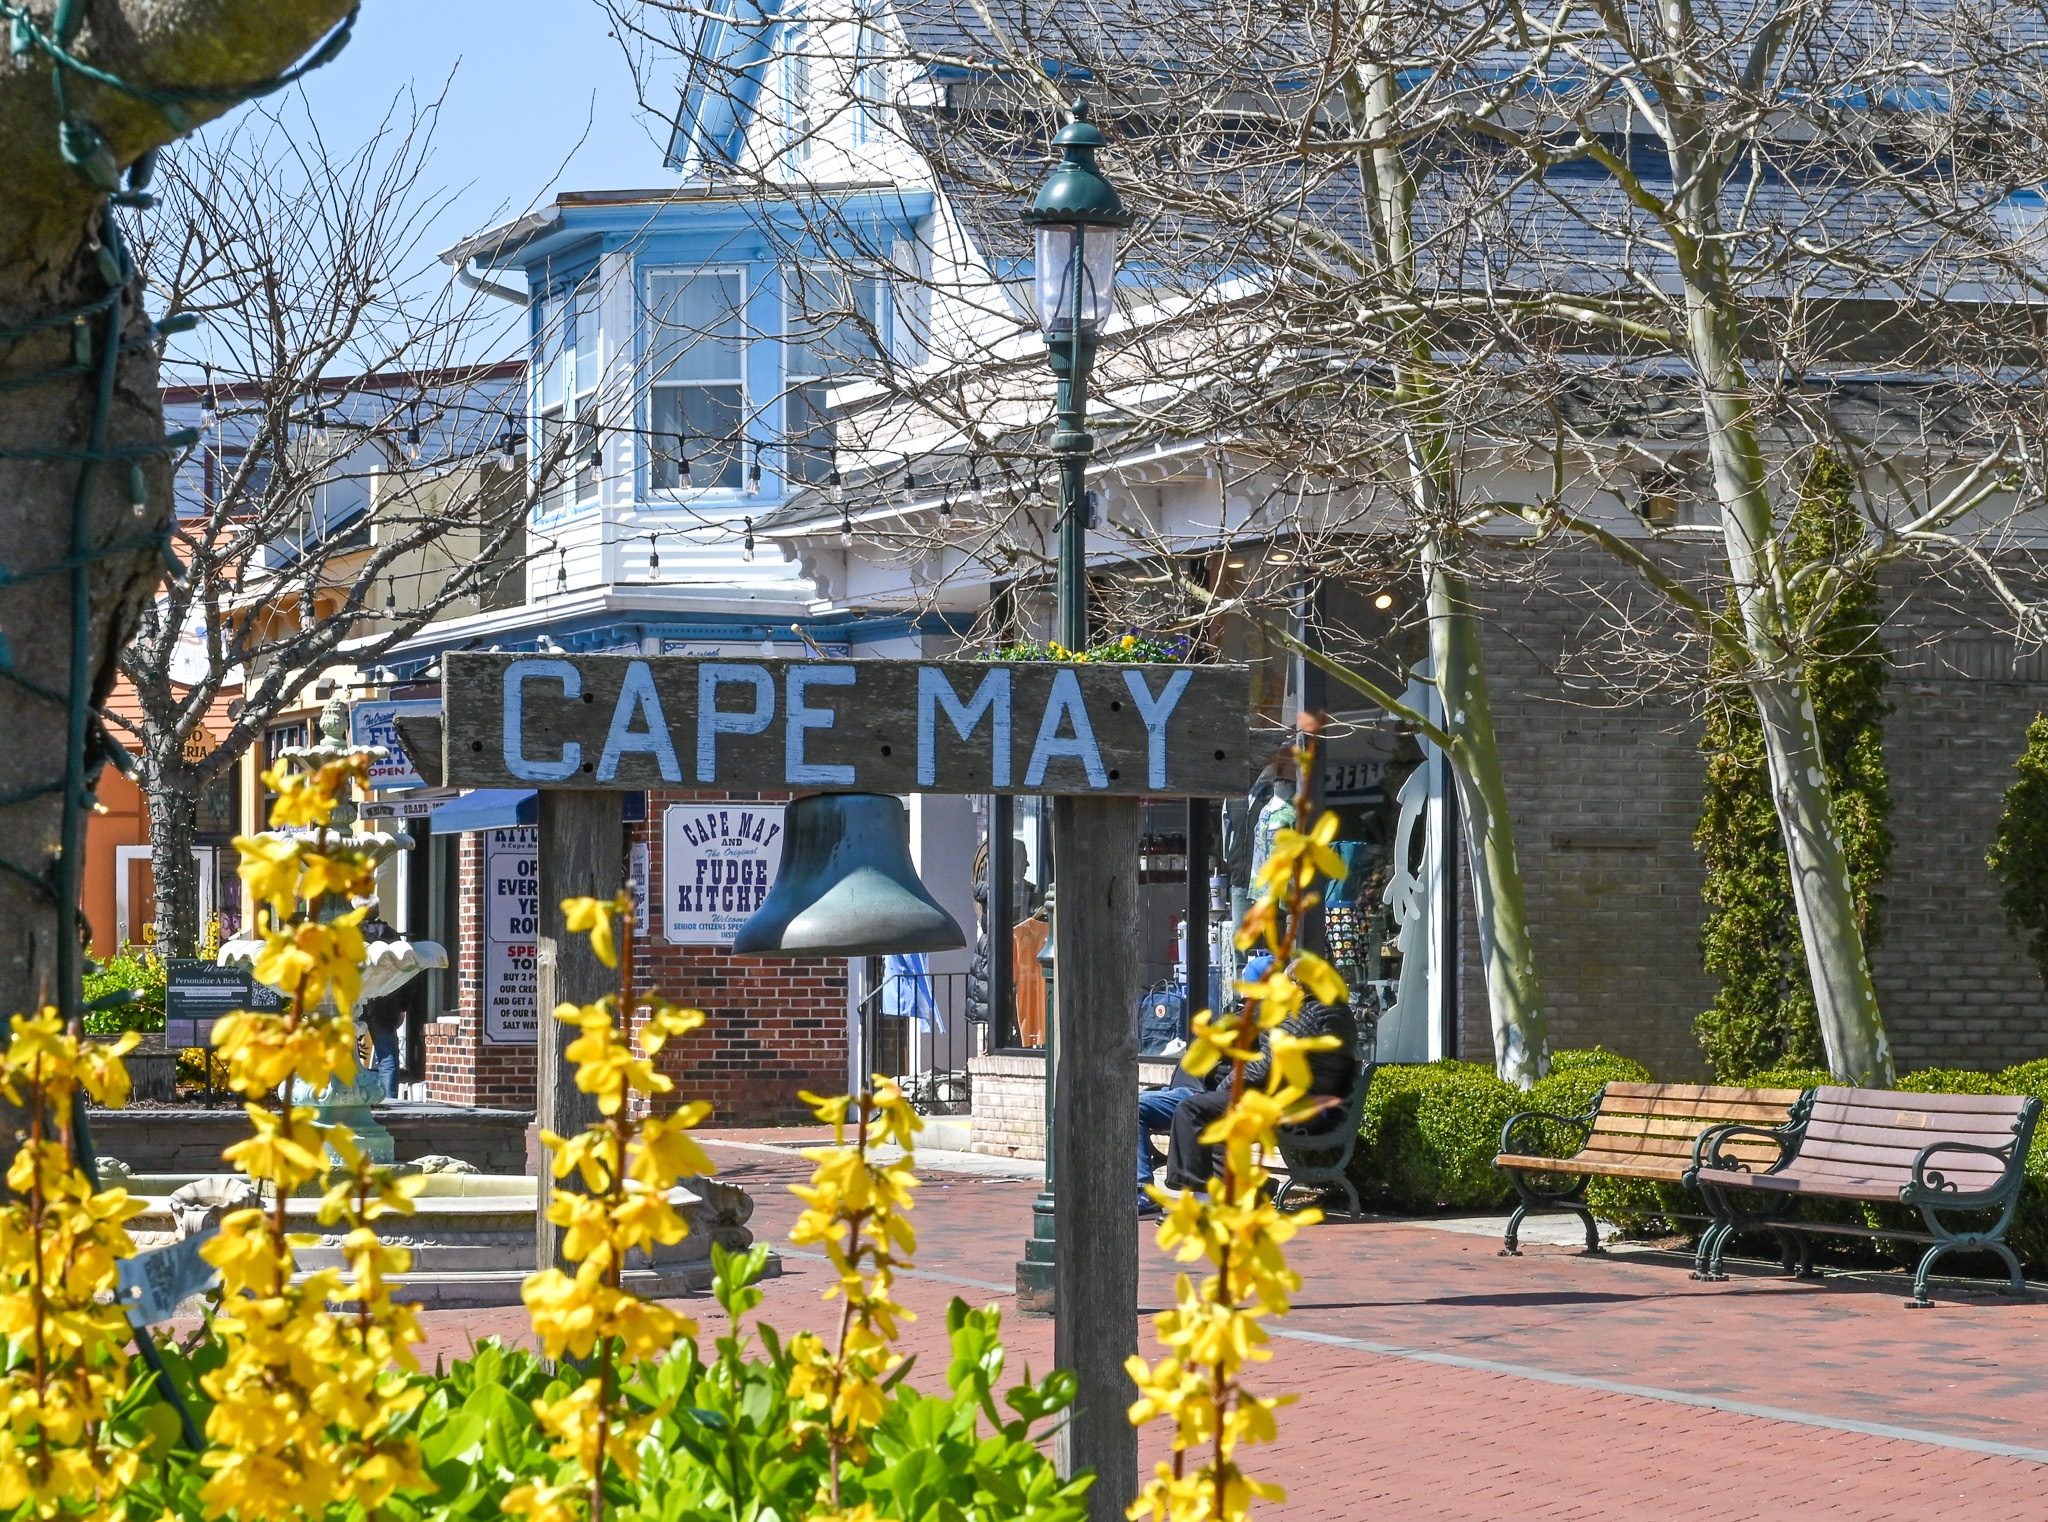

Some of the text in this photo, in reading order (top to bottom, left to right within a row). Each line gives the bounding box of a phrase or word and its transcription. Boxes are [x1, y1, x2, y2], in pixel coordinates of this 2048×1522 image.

[503, 659, 1193, 789] CAPE MAY
[375, 747, 405, 765] IT
[368, 767, 404, 777] OPEN
[404, 803, 428, 814] GRAND
[683, 811, 780, 847] CAPE MAY
[721, 838, 743, 847] AND
[705, 847, 759, 858] The Original
[696, 859, 767, 885] FUDGE
[498, 879, 538, 896] EVER
[679, 885, 772, 912] KITCHE
[518, 898, 538, 915] YE
[674, 923, 697, 931] SENIOR
[698, 923, 727, 931] CITIZENS
[507, 946, 537, 957] SPE
[175, 977, 241, 985] Personalize A Brick
[503, 973, 519, 981] BUY
[521, 973, 526, 981] 2
[500, 985, 516, 993] OUR
[493, 997, 533, 1006] AND GET A
[500, 1009, 510, 1017] OF
[512, 1009, 529, 1017] OUR
[503, 1021, 538, 1030] SALT WAT
